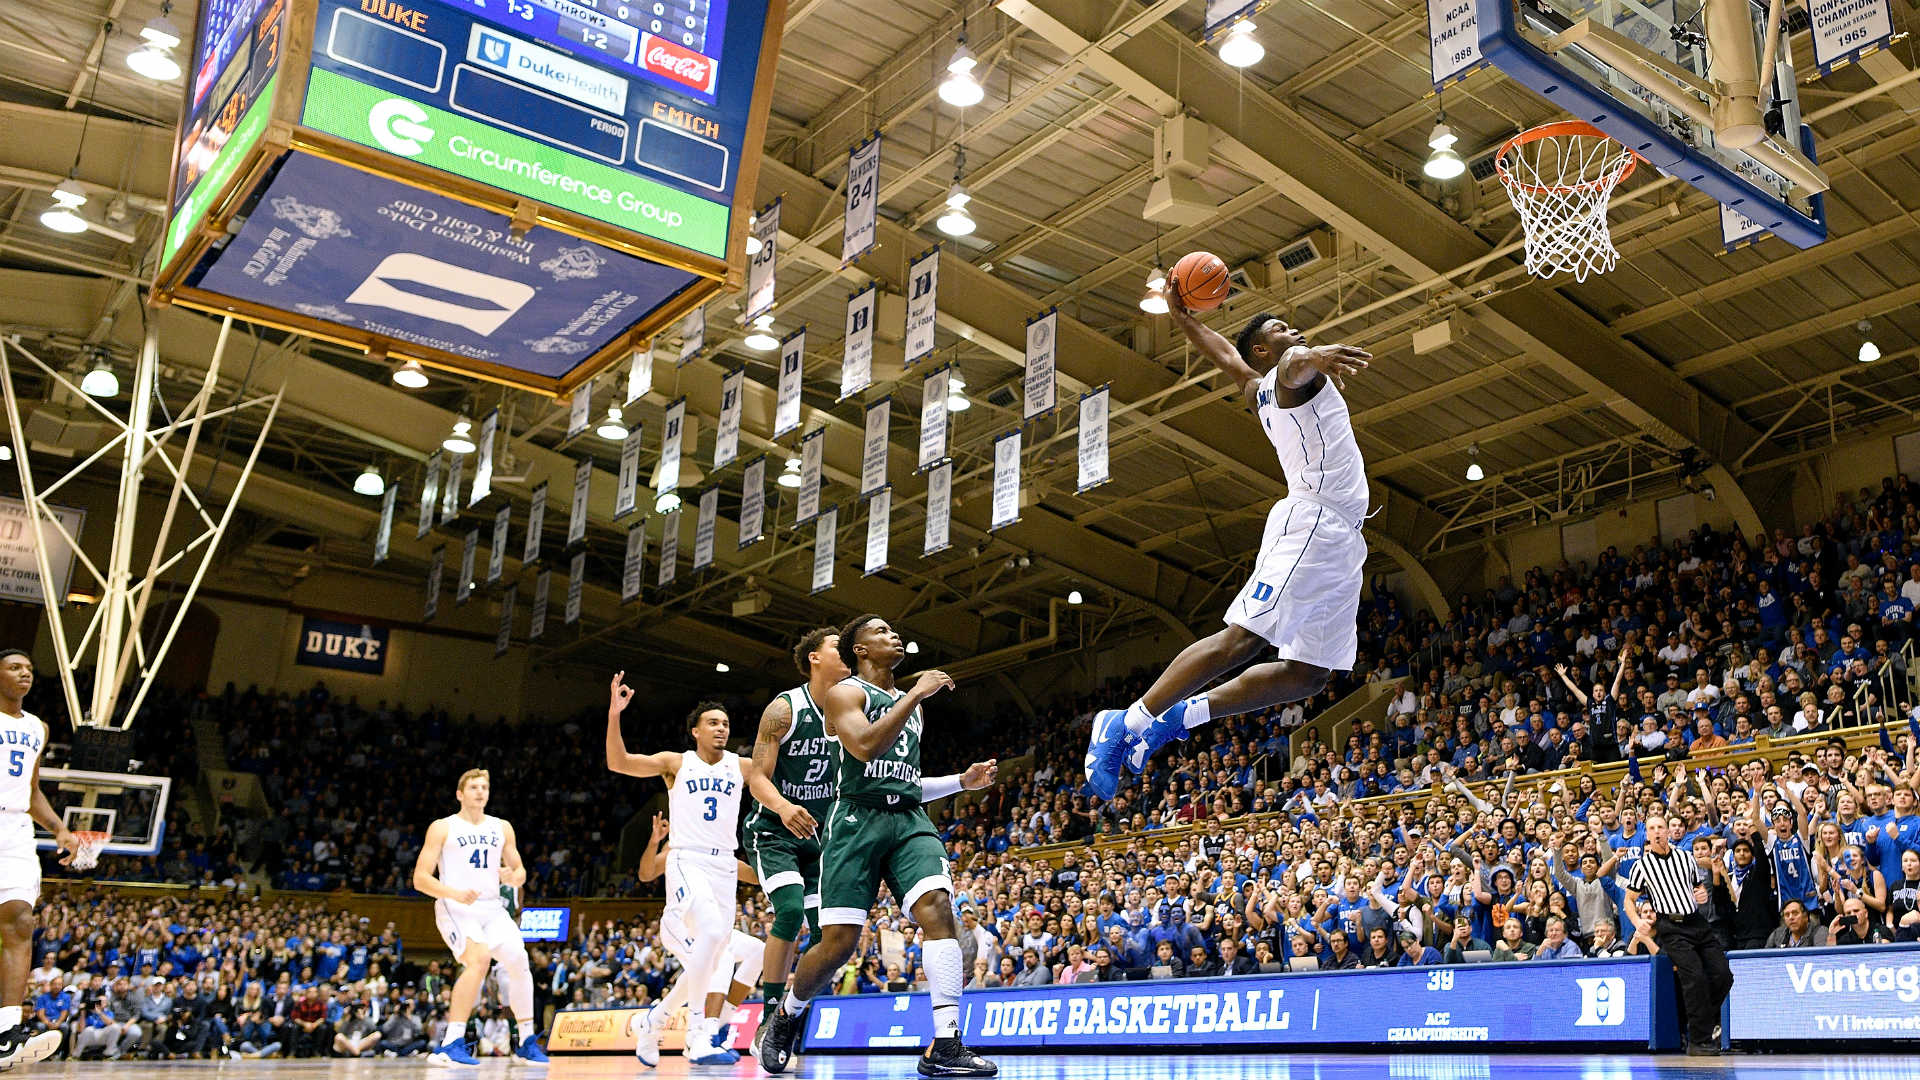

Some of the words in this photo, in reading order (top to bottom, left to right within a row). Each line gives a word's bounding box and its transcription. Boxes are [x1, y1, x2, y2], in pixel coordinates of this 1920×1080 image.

[1446, 2, 1469, 22] NCAA
[1824, 22, 1852, 38] REGULAR
[1853, 9, 1877, 25] SEASON
[582, 28, 608, 50] 1-2
[1434, 27, 1457, 47] FINAL
[1838, 27, 1867, 46] 1965
[518, 55, 620, 101] DukeHealth
[590, 118, 624, 139] PERIOD
[653, 101, 721, 140] EMICH
[448, 136, 612, 204] Circumference
[617, 191, 683, 229] Group
[850, 175, 872, 211] 24
[377, 206, 427, 232] Duke
[394, 199, 438, 222] Club
[440, 215, 482, 237] Golf
[431, 225, 530, 265] Washington
[1252, 581, 1273, 602] D
[305, 631, 380, 660] DUKE
[0, 730, 40, 752] UKE
[788, 738, 831, 756] EAST
[895, 730, 909, 757] 3
[8, 750, 24, 777] 5
[804, 759, 829, 782] 21
[686, 778, 735, 796] DUKE
[703, 797, 717, 821] 3
[457, 834, 499, 847] DUKE
[469, 849, 488, 868] 41
[1787, 862, 1799, 878] 4
[1426, 969, 1454, 991] 39
[1574, 977, 1626, 1026] D
[981, 998, 1062, 1037] DUKE
[1064, 989, 1290, 1036] BASKETBALL
[1425, 1012, 1450, 1026] ACC
[1815, 1015, 1839, 1031] TV
[1387, 1027, 1489, 1041] CHAMPIONSHIPS
